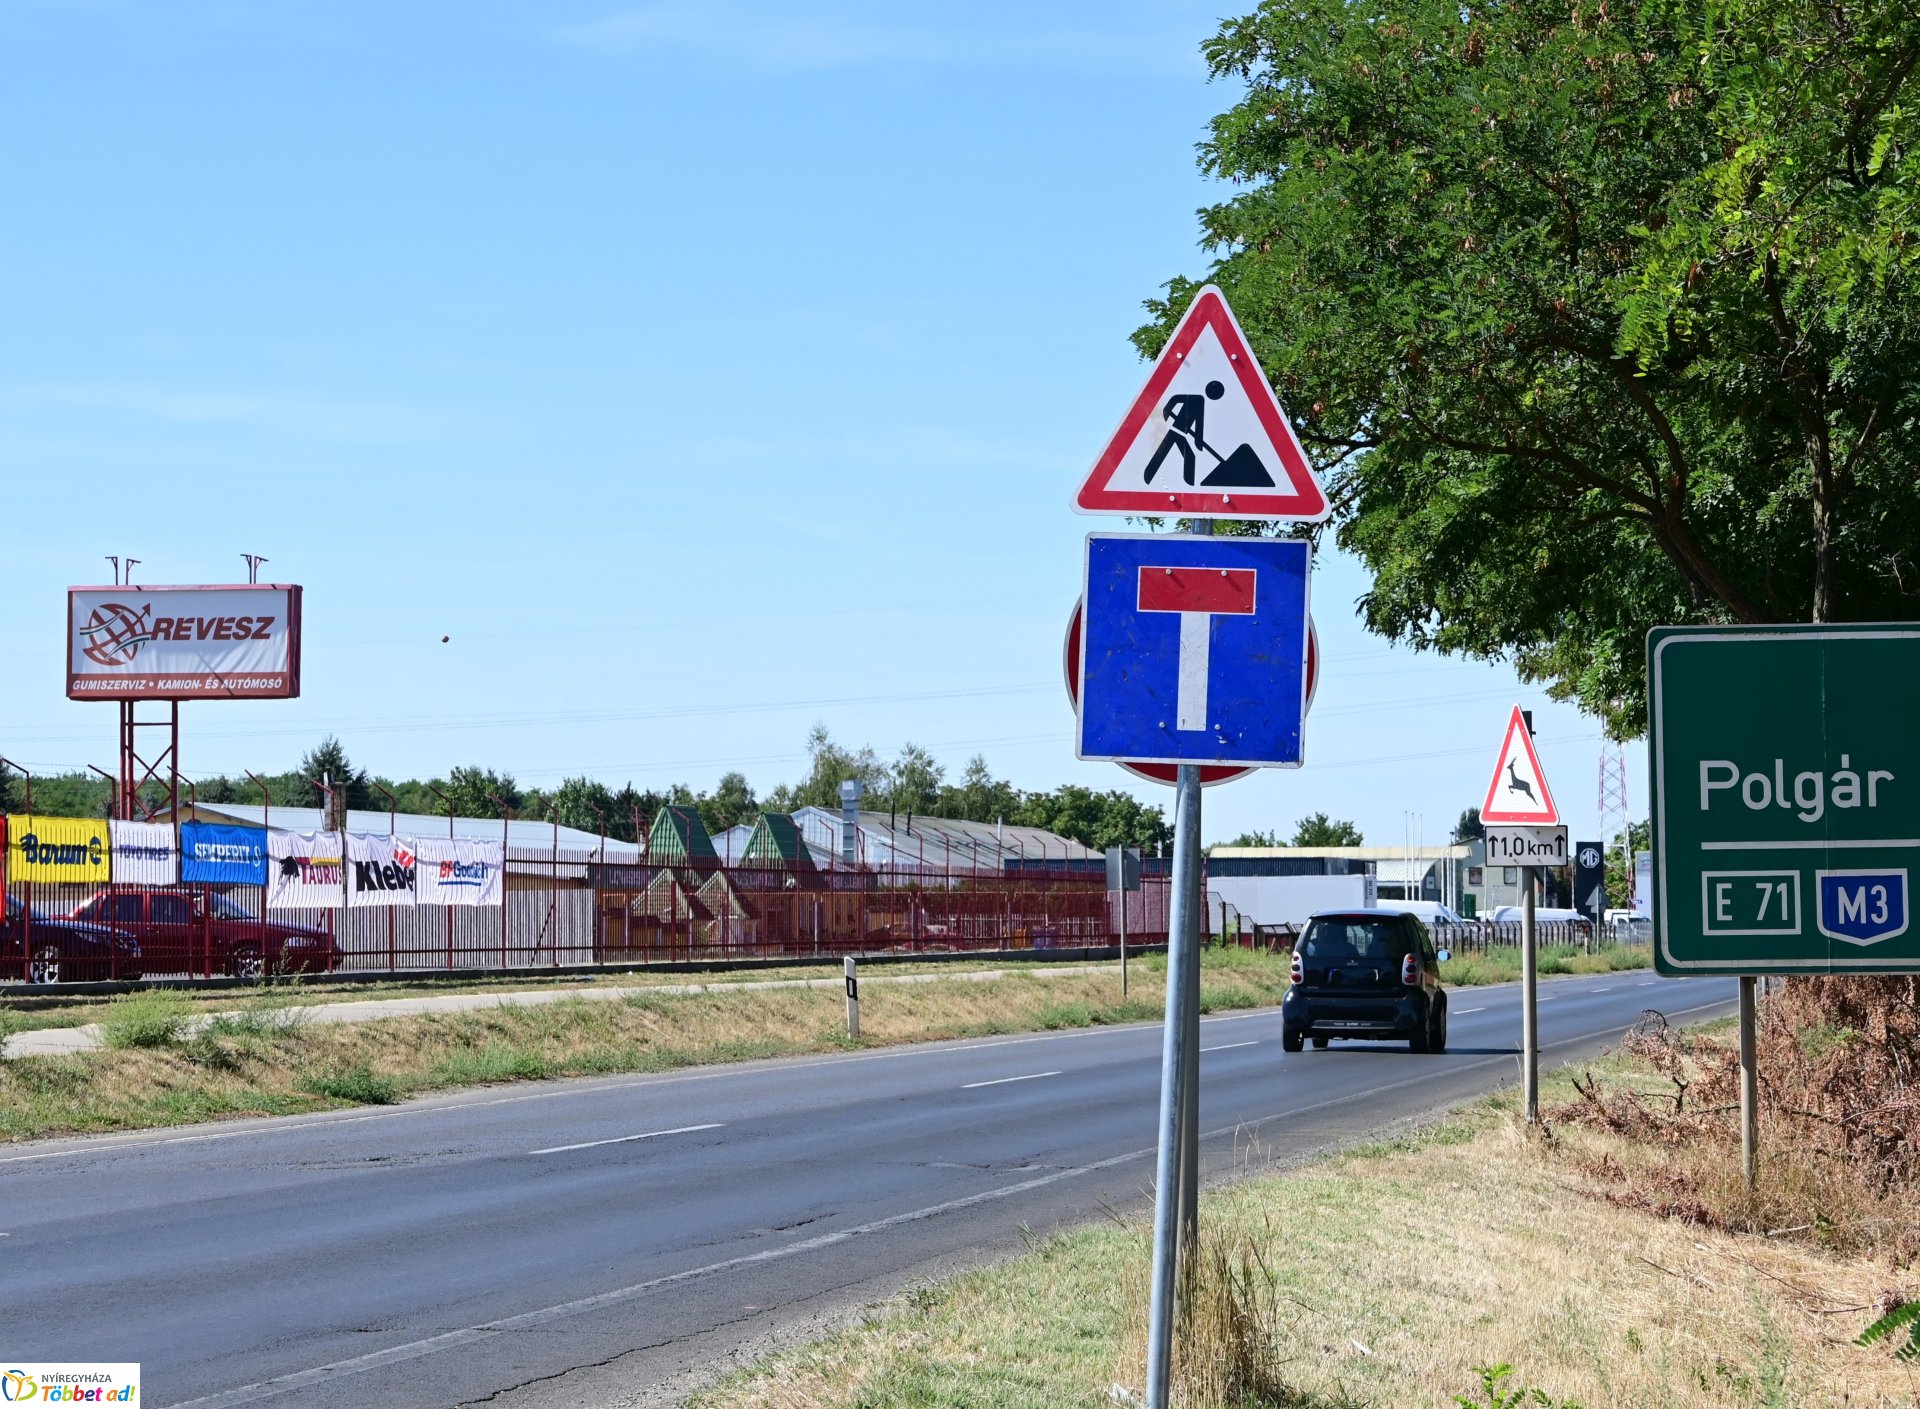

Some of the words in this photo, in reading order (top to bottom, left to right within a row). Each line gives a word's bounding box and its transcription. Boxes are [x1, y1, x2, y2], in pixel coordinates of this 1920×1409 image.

[72, 679, 147, 690] GUMISZERVIZ
[204, 677, 220, 689] ÉS
[221, 676, 283, 689] AUTÓMOSÓ
[1699, 753, 1896, 823] Polgár
[19, 832, 88, 865] Barum
[194, 842, 250, 864] SEMPERIT
[1527, 839, 1553, 856] km
[1580, 849, 1599, 867] MG
[1715, 882, 1732, 921] E
[1755, 881, 1789, 921] 71
[1837, 885, 1889, 925] M3
